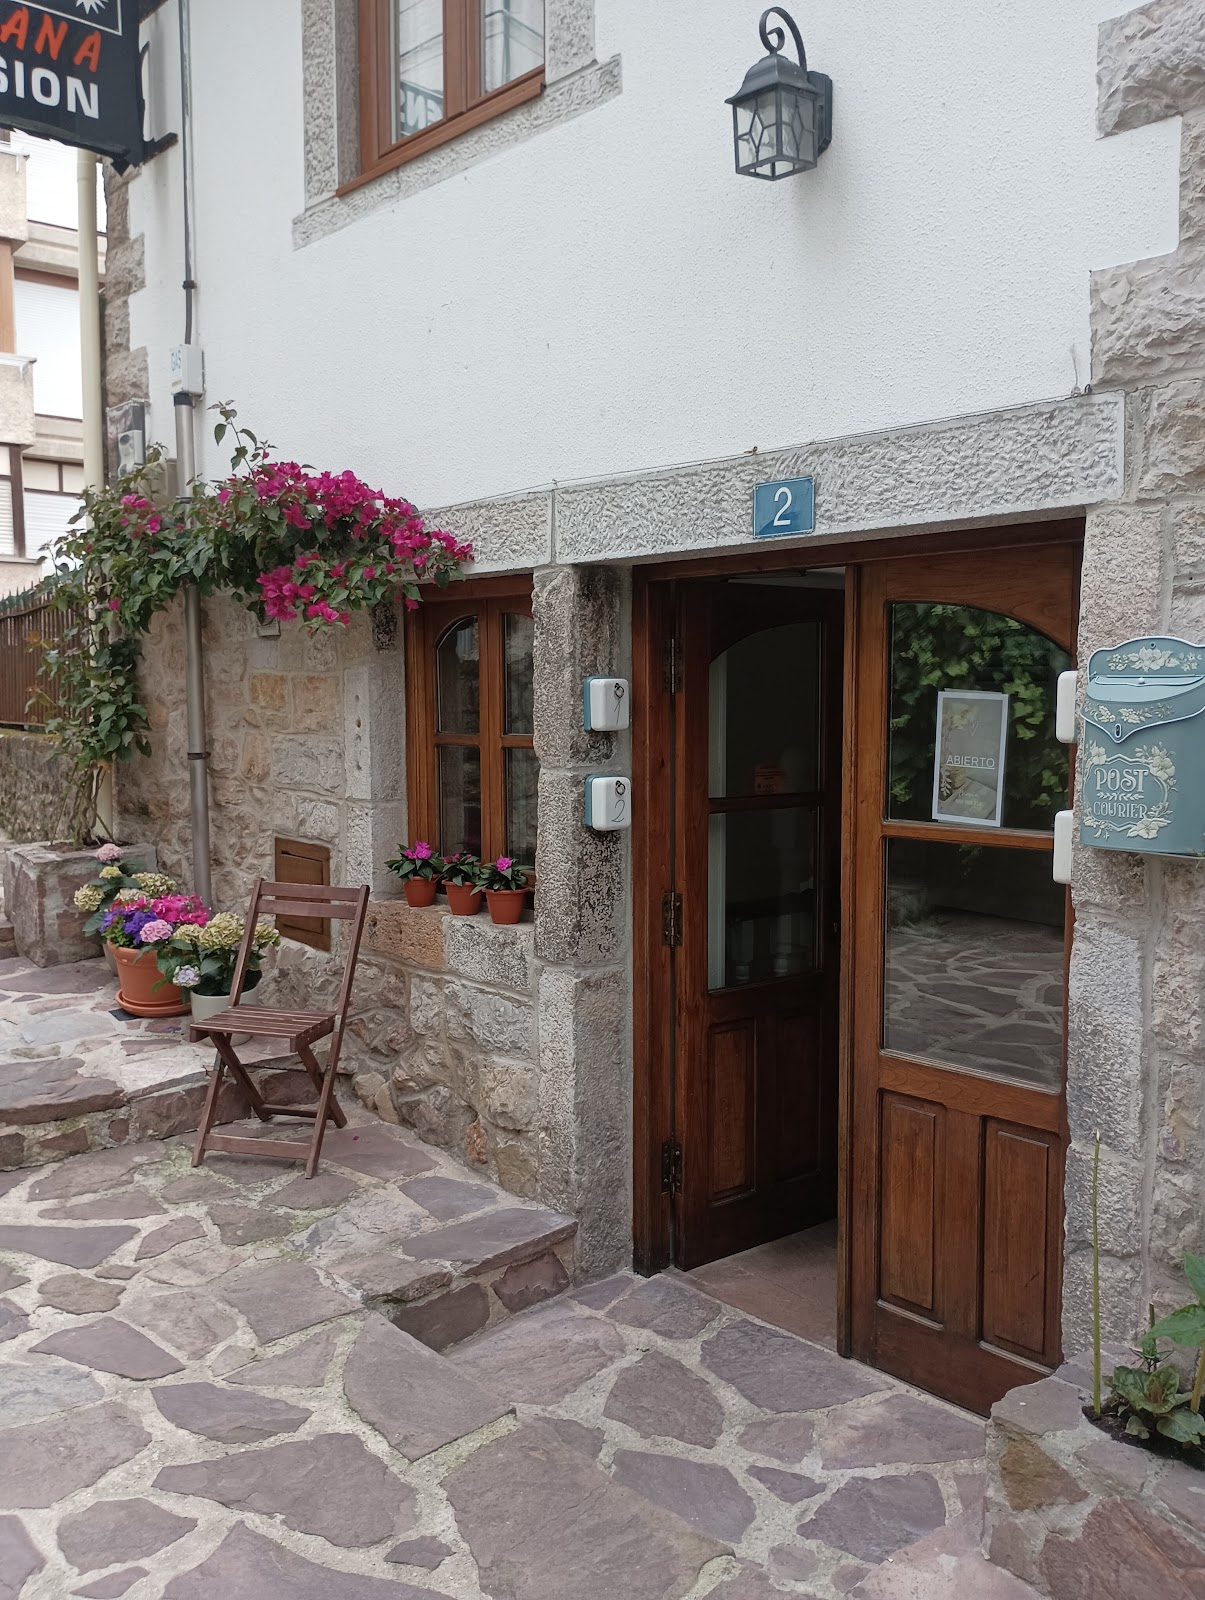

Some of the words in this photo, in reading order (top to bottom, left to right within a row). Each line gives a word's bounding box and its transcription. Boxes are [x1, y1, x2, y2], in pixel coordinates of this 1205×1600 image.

[0, 6, 102, 73] ANA
[773, 486, 792, 526] 2
[613, 699, 621, 726] 1
[946, 754, 995, 768] ABIERTO
[1094, 767, 1149, 792] POST
[611, 799, 626, 823] 2
[1093, 801, 1148, 819] COURIER
